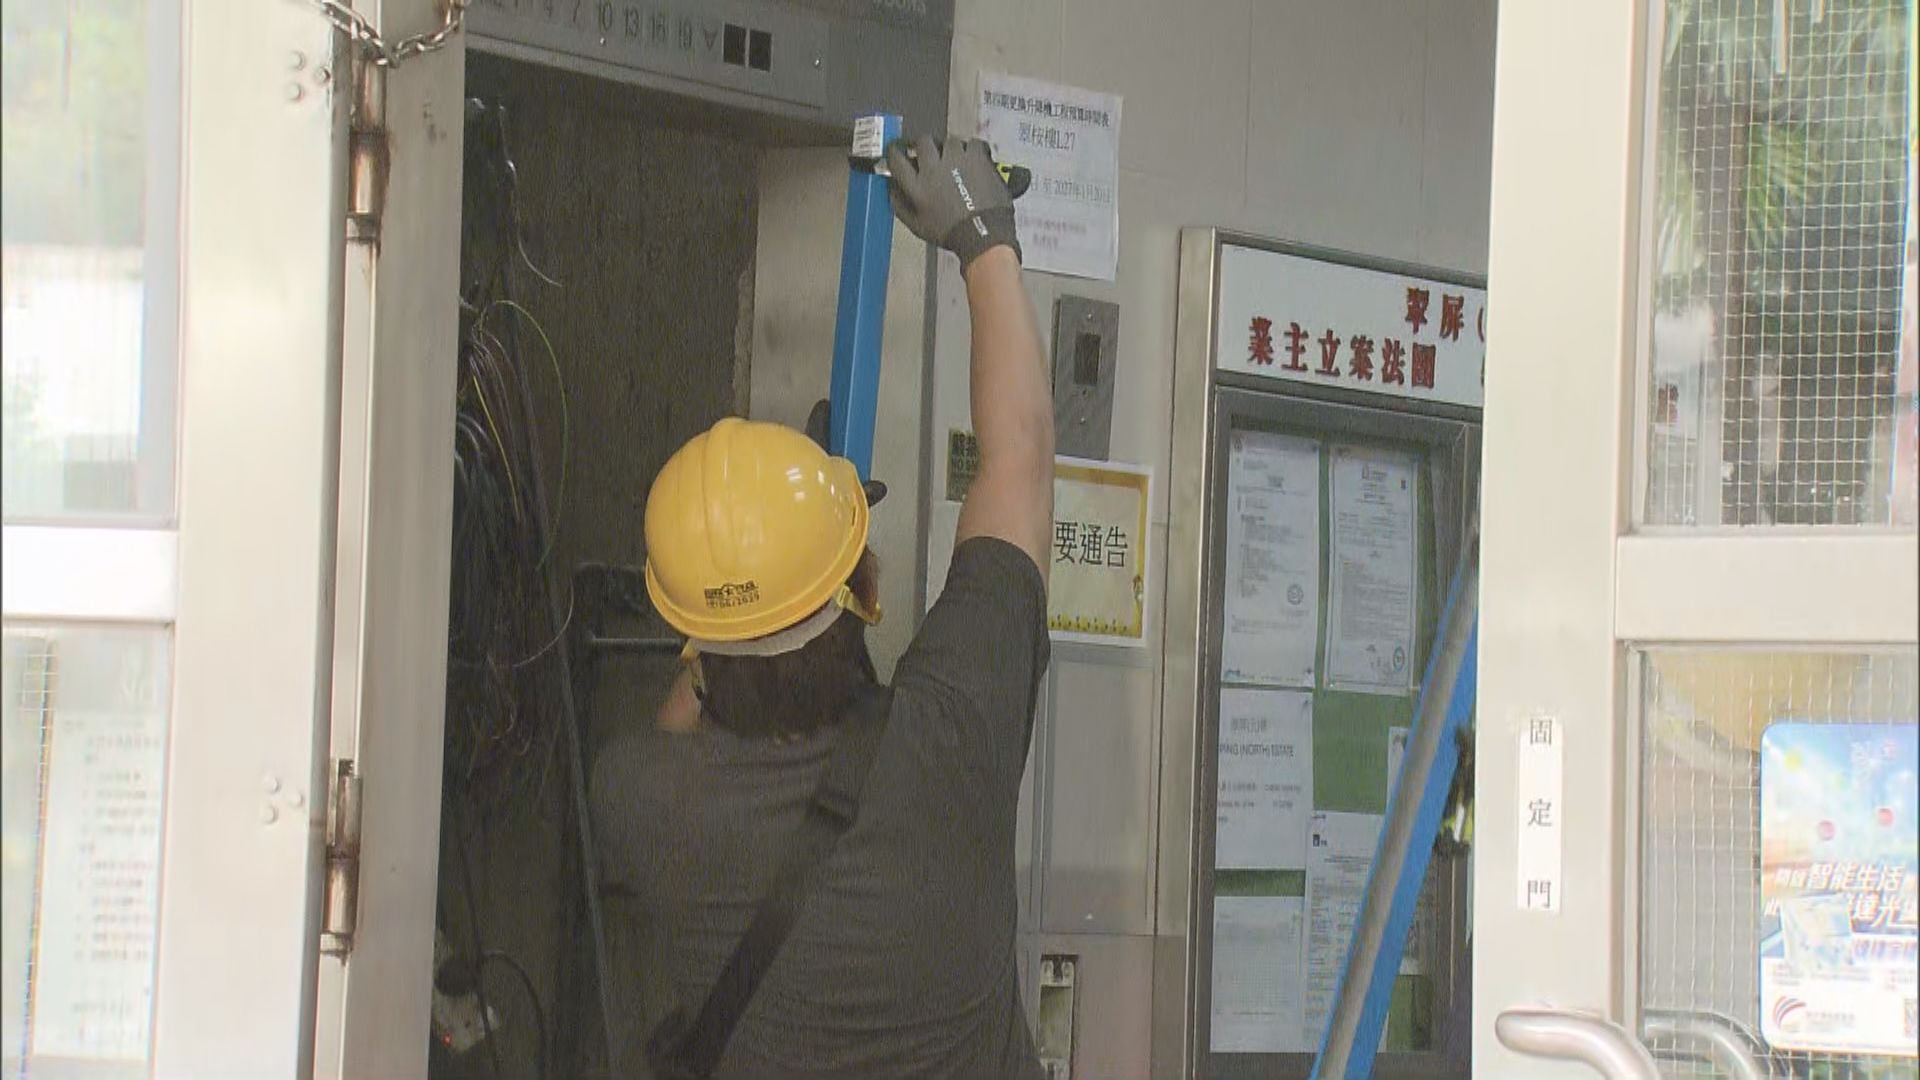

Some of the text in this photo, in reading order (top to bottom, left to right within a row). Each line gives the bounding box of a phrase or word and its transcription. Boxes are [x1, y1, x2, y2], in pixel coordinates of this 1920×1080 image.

[623, 6, 640, 39] 13
[1248, 316, 1436, 389] 業主立案法團
[1528, 718, 1553, 908] 固定門
